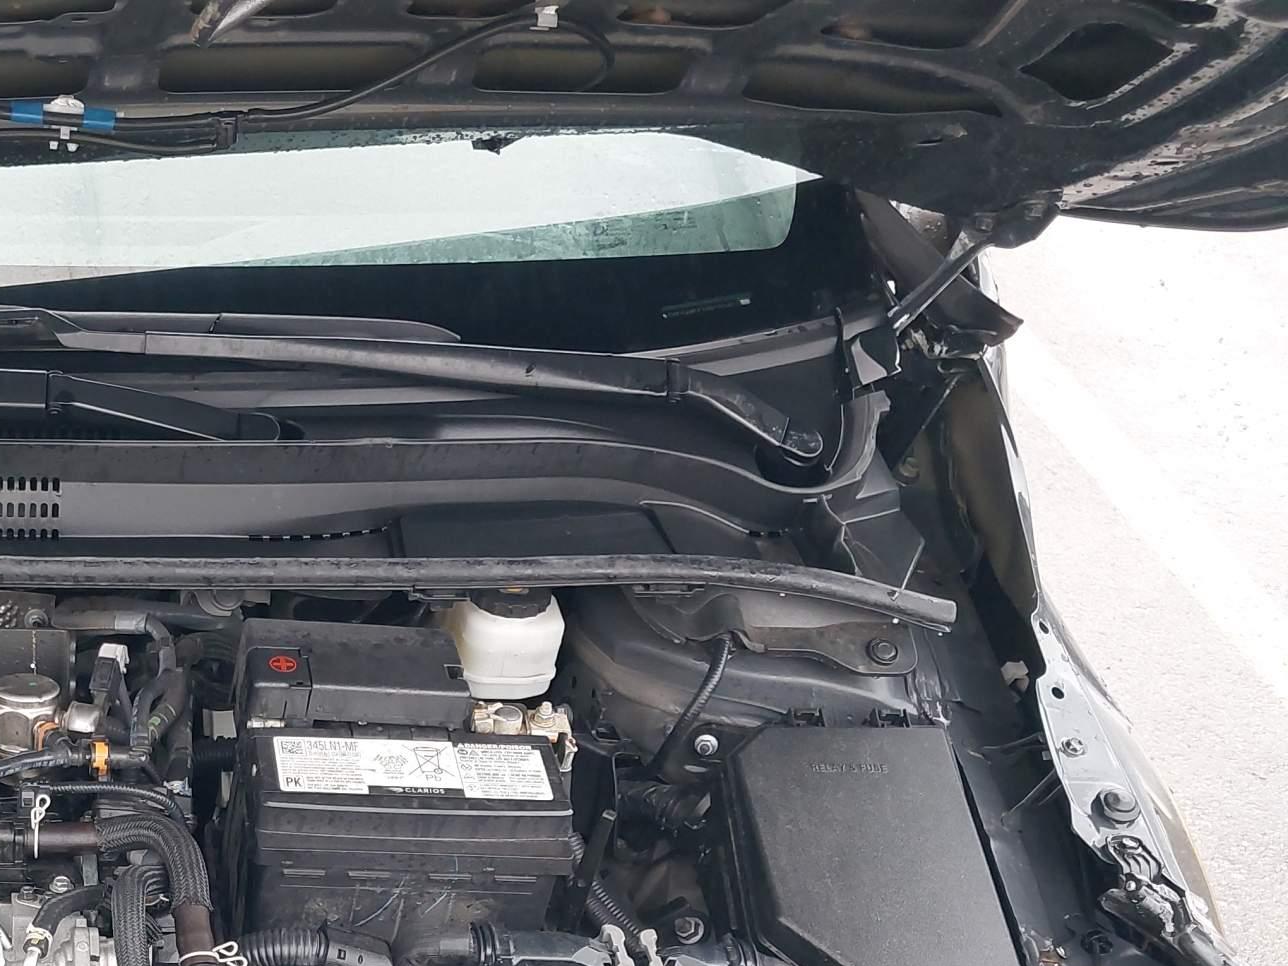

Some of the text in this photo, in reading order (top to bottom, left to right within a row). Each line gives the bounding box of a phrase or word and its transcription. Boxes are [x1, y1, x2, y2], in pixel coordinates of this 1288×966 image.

[307, 740, 359, 751] 345LN1-MF
[285, 776, 302, 788] PK
[404, 787, 446, 795] CLARIOS
